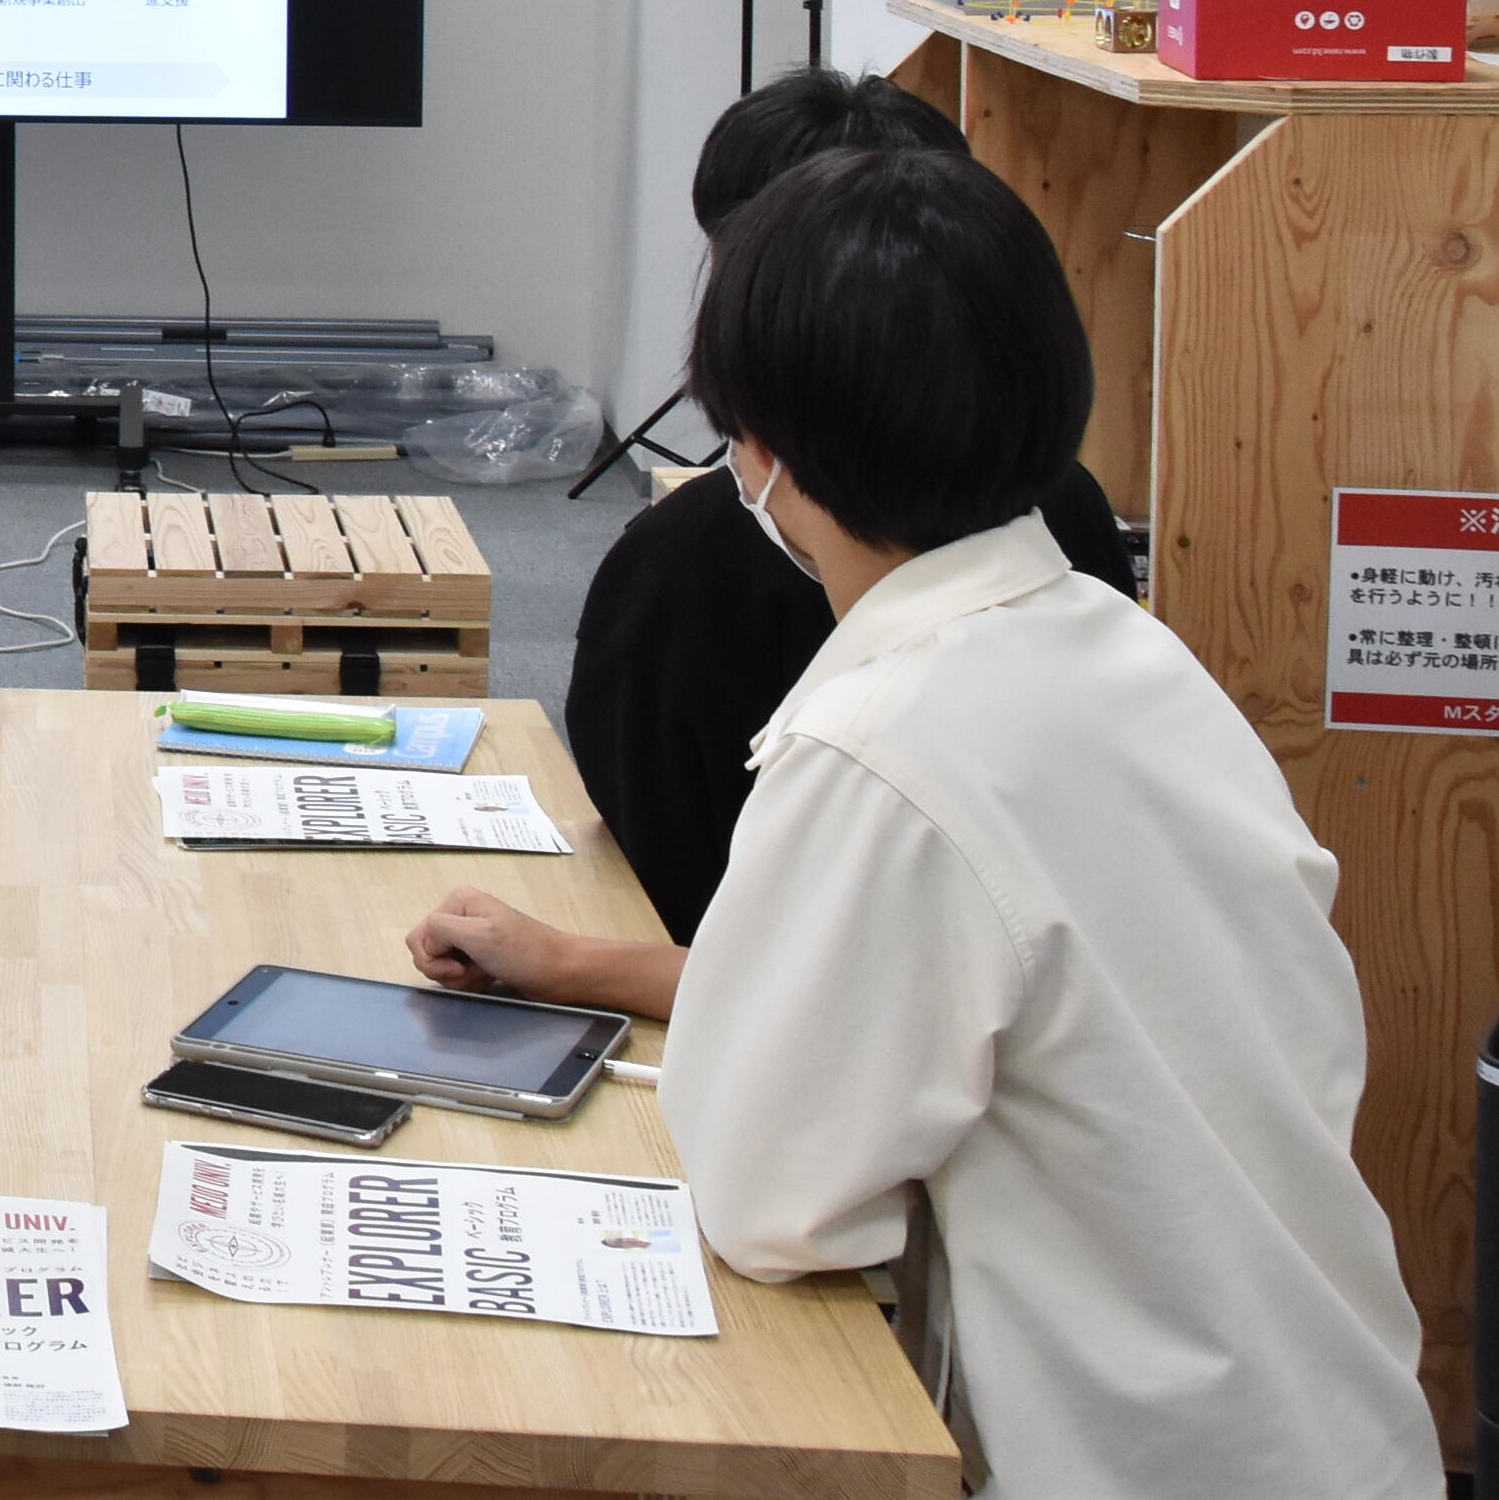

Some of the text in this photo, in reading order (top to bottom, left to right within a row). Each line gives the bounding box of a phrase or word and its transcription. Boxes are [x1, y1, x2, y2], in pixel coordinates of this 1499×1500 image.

[393, 711, 451, 760] Campus
[190, 1158, 231, 1219] MEIJO UNIV.
[492, 1186, 523, 1244] 教育プログラム
[4, 1213, 77, 1232] UNIV.
[347, 1174, 445, 1306] EXPLORER
[461, 1201, 485, 1240] ベーシック
[464, 1248, 537, 1314] BASIC
